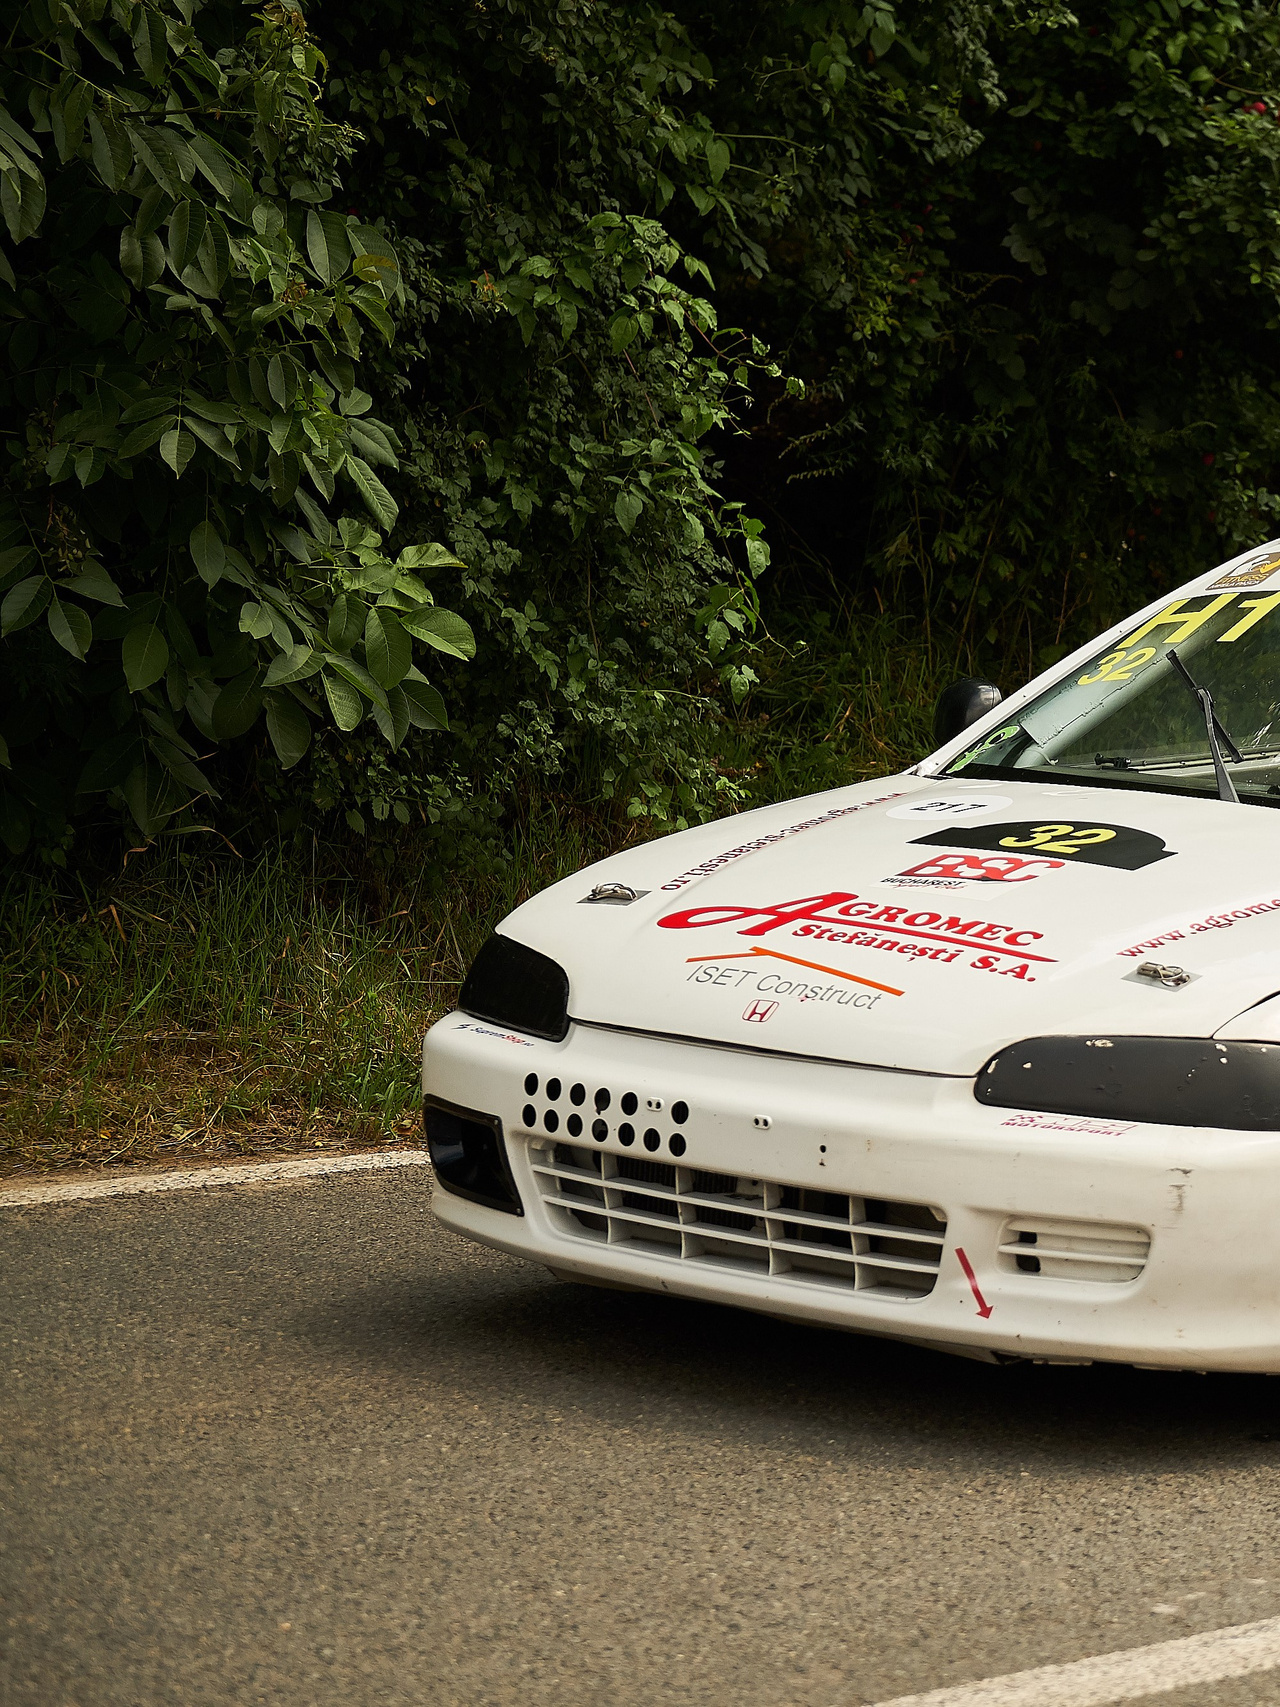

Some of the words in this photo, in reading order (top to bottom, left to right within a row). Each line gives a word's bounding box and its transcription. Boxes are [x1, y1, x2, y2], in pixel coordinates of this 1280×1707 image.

[1077, 647, 1156, 685] 32
[998, 824, 1116, 854] 32
[656, 891, 1044, 946] AGROMEC
[970, 955, 1037, 982] S.A.
[685, 963, 750, 989] ISET
[756, 972, 883, 1011] Construct
[1000, 1121, 1126, 1137] MOTORSPORT
